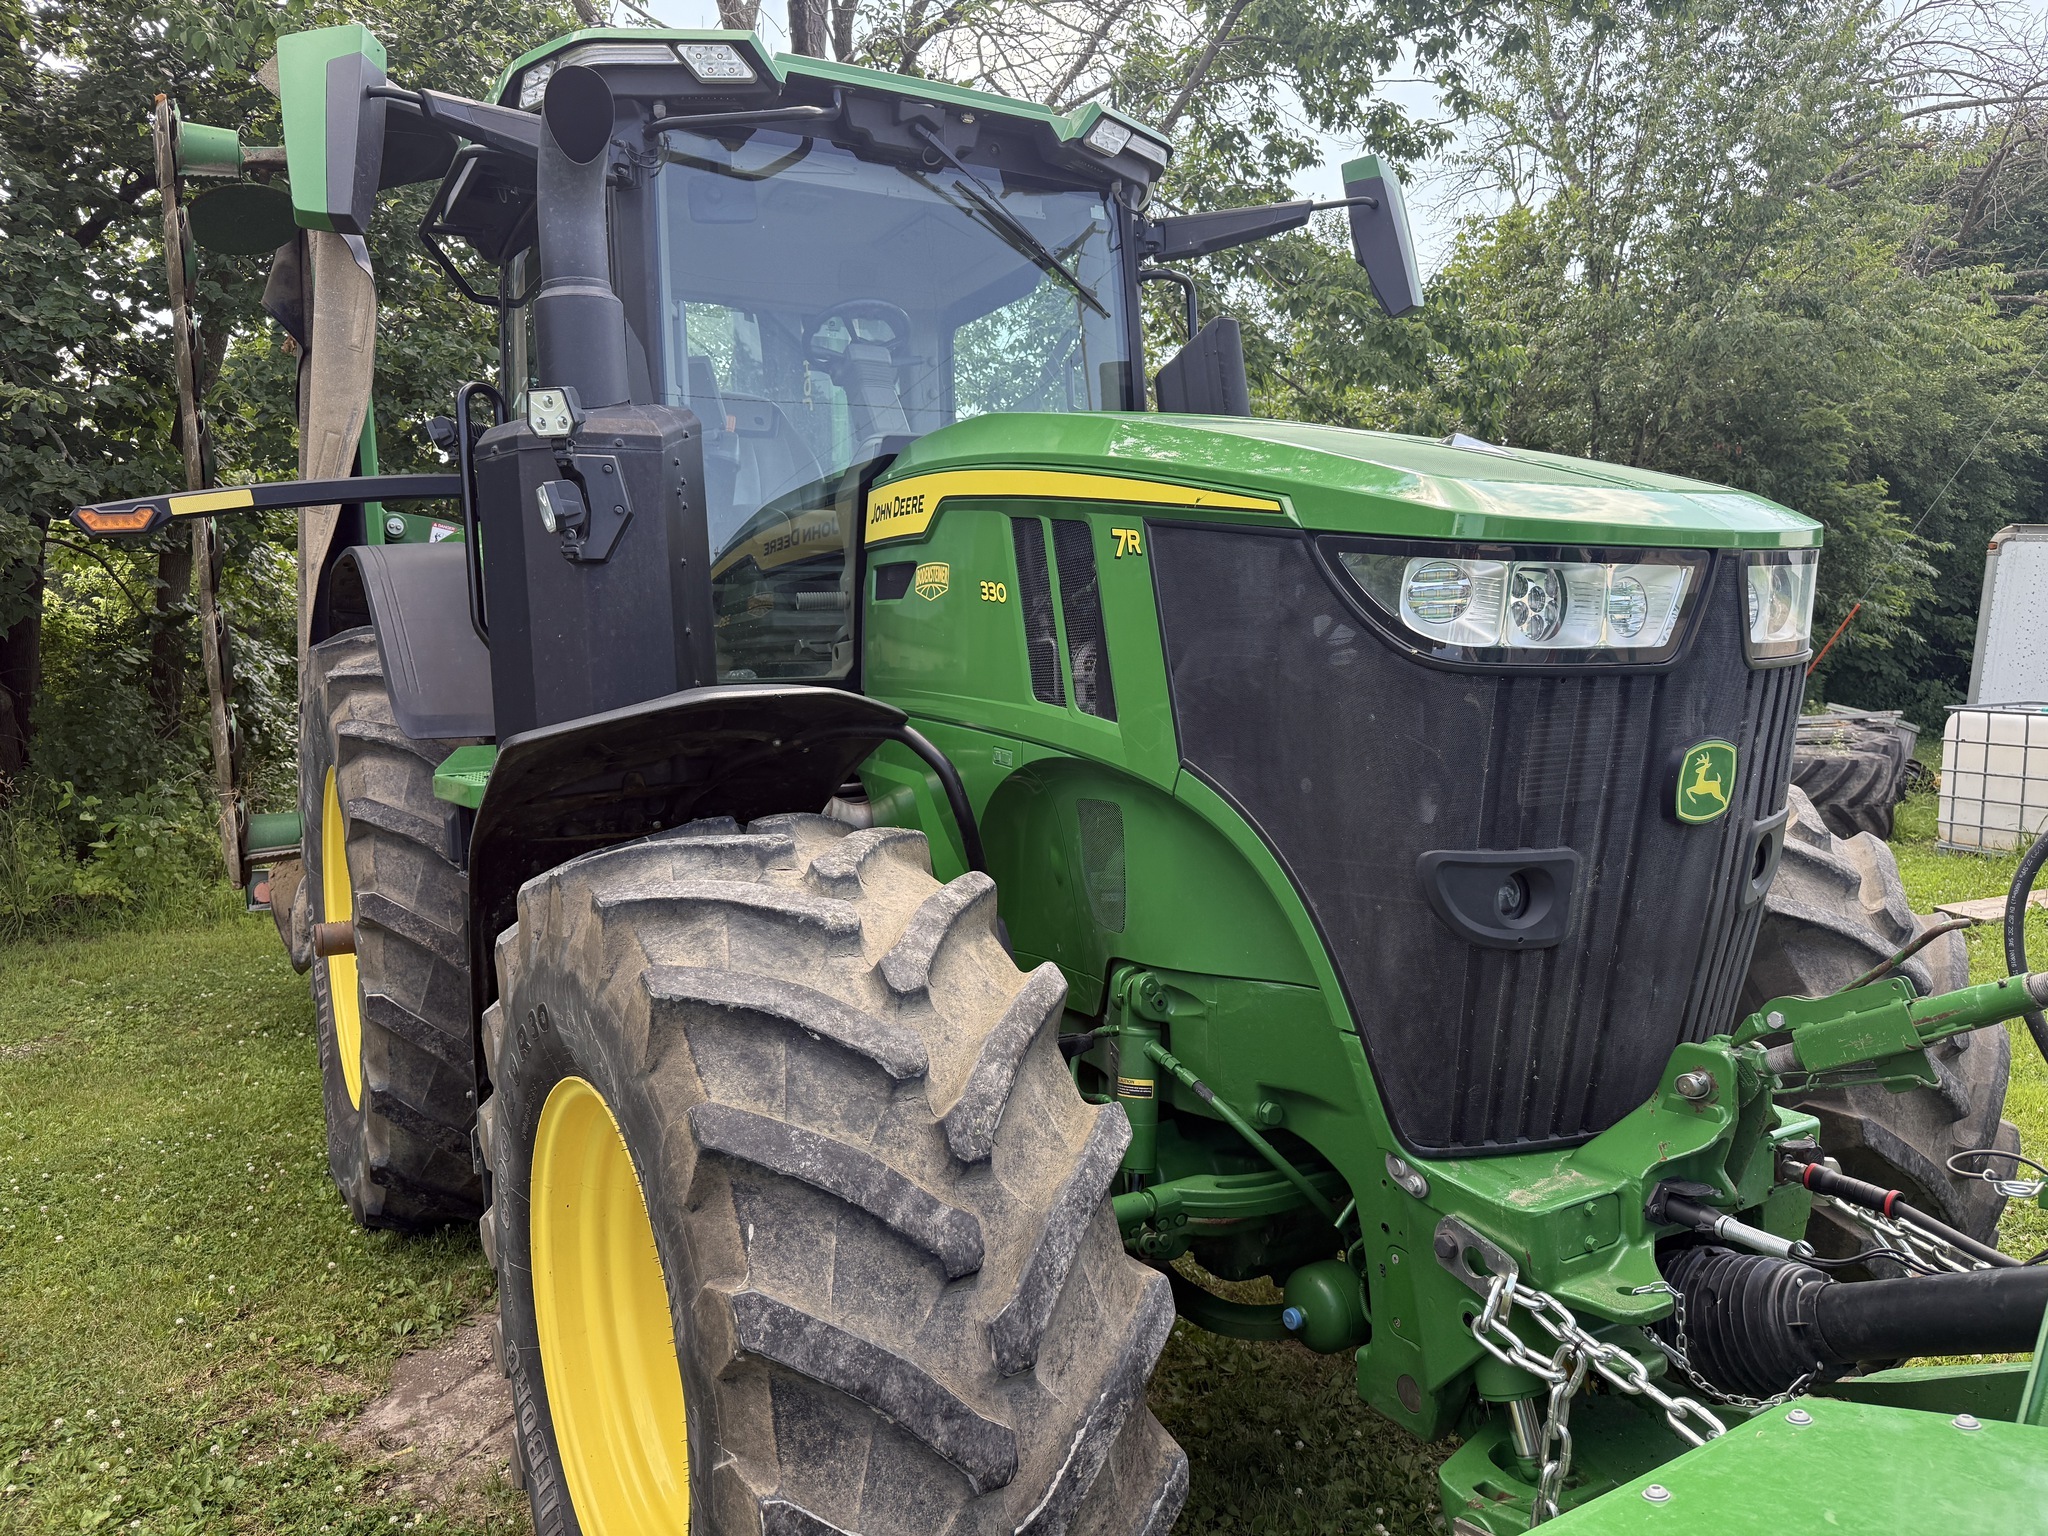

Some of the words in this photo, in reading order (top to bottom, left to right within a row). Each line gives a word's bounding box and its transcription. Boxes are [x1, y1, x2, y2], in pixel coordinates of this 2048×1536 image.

[871, 502, 893, 525] JOHN
[893, 494, 925, 518] DEERE
[438, 523, 457, 532] DANGER
[1111, 527, 1143, 559] 7R
[980, 580, 1007, 603] 330
